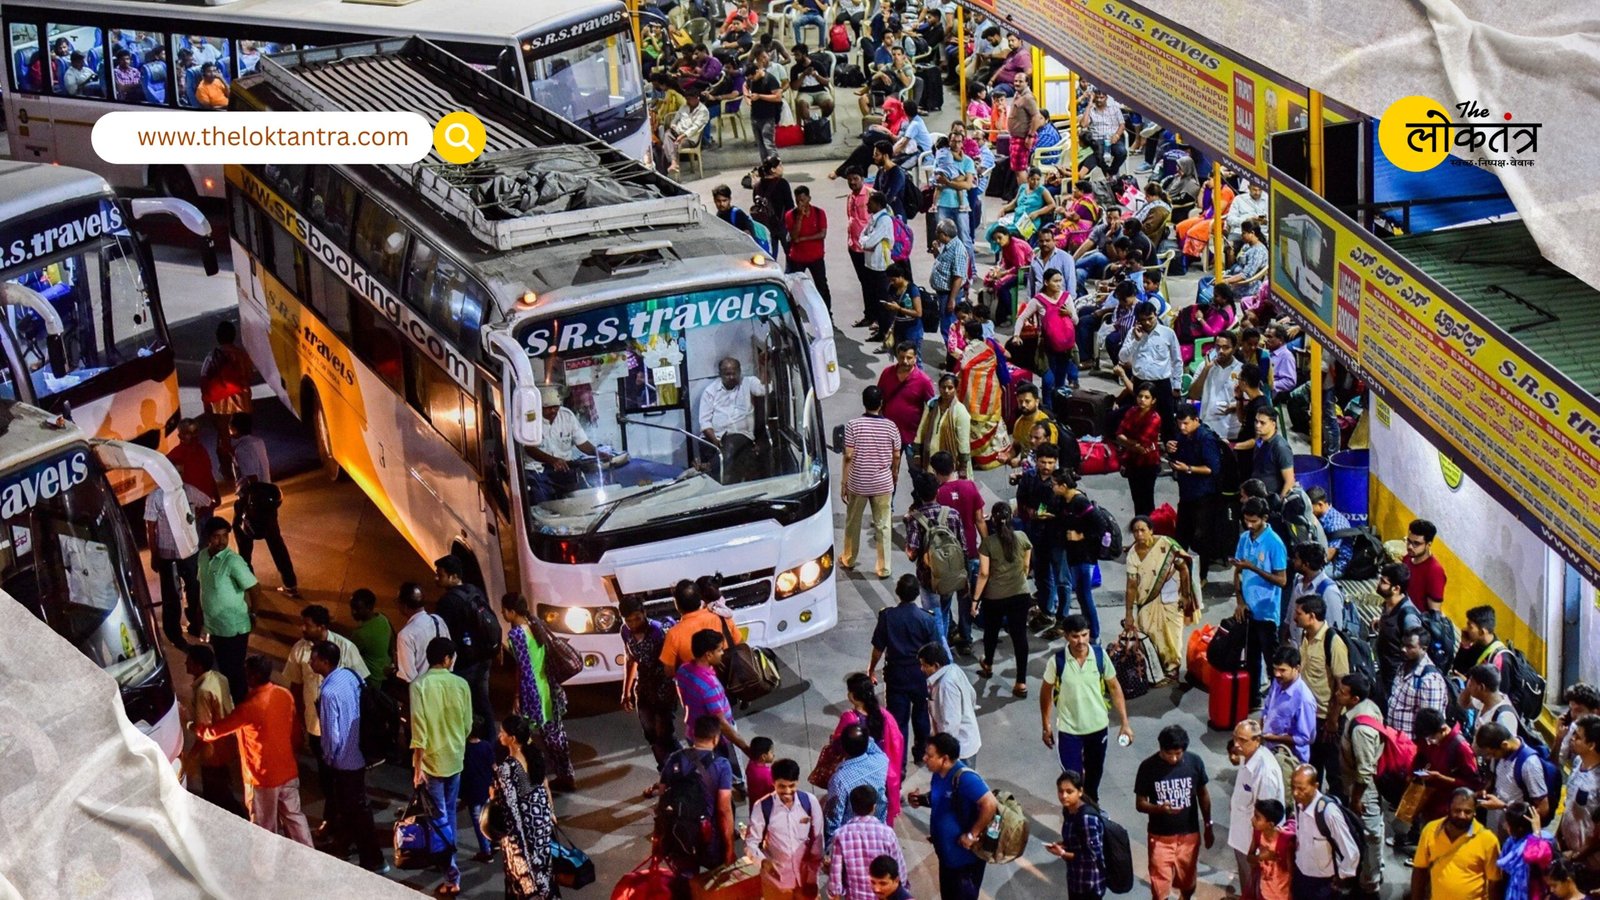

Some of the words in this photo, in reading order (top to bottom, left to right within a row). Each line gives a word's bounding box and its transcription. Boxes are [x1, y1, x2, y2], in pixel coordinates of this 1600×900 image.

[1103, 3, 1145, 32] S.R.S.
[1150, 27, 1220, 70] travels
[1105, 20, 1138, 42] PARCEL
[1139, 39, 1184, 67] SERVICES
[1185, 65, 1199, 75] TO
[1270, 293, 1386, 396] www.srsbooking.com
[1373, 289, 1401, 314] DAILY
[1403, 311, 1434, 341] TRIPS
[1450, 347, 1498, 391] EXPRESS
[1499, 386, 1544, 426] PARCEL
[1498, 360, 1560, 416] S.R.S.
[1154, 777, 1193, 792] BELIEVE
[1157, 791, 1167, 800] IN
[1167, 787, 1192, 800] YOUR
